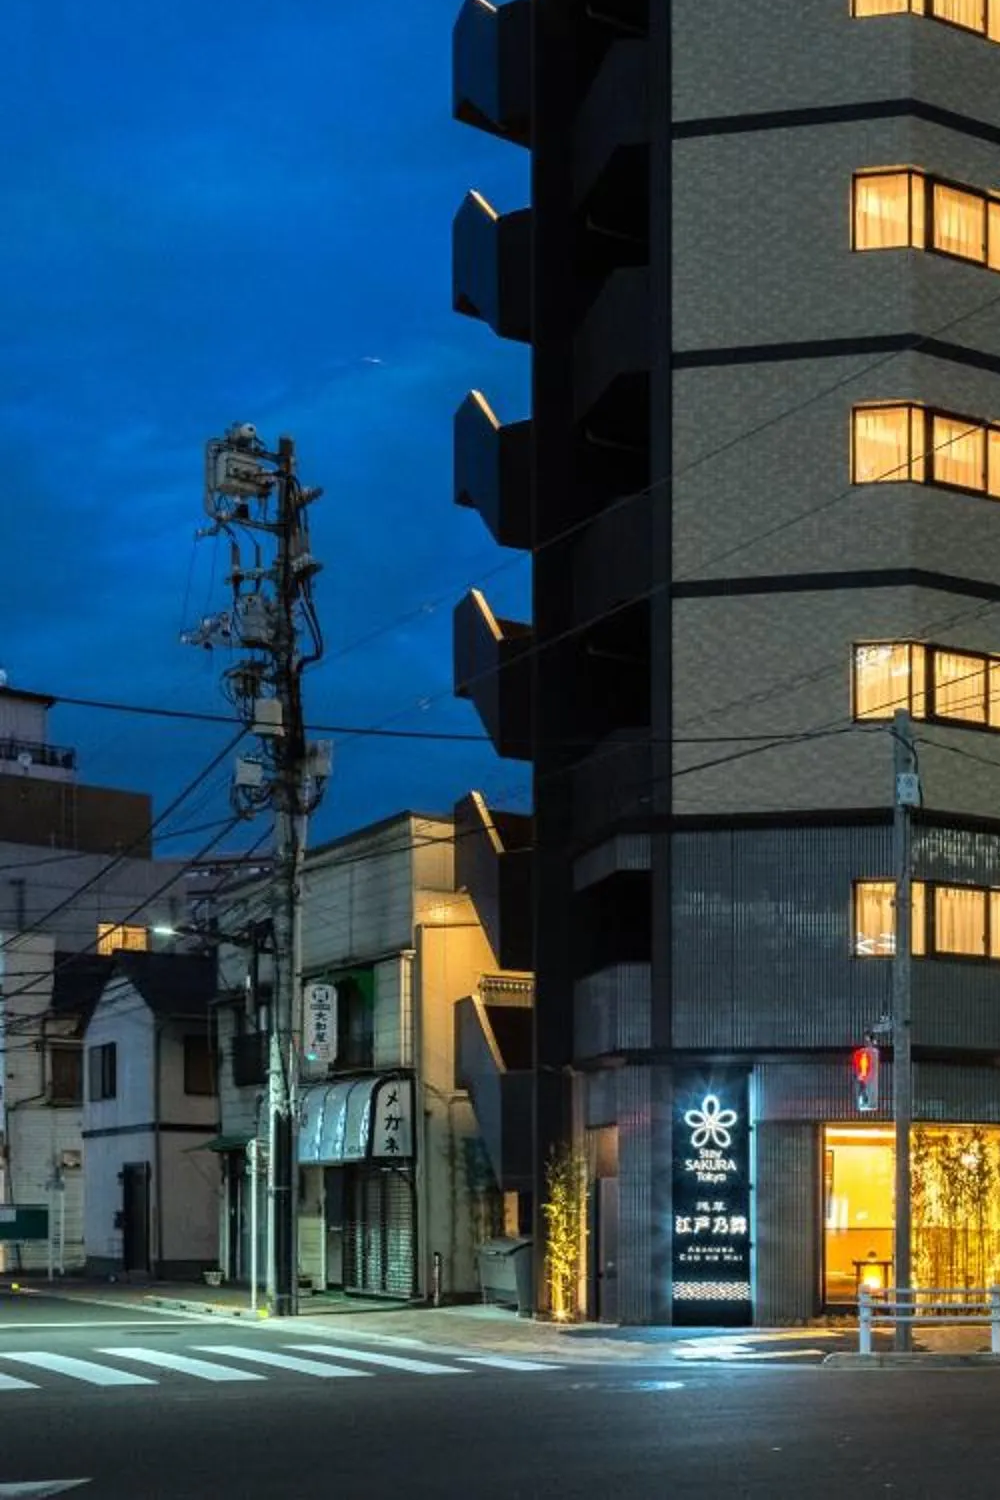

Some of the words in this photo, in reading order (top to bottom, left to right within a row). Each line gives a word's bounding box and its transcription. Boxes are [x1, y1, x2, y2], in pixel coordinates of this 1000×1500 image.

[383, 1089, 403, 1154] メガネ
[699, 1148, 723, 1159] Stay
[684, 1159, 738, 1171] SAKURA
[696, 1171, 728, 1185] Tokyo
